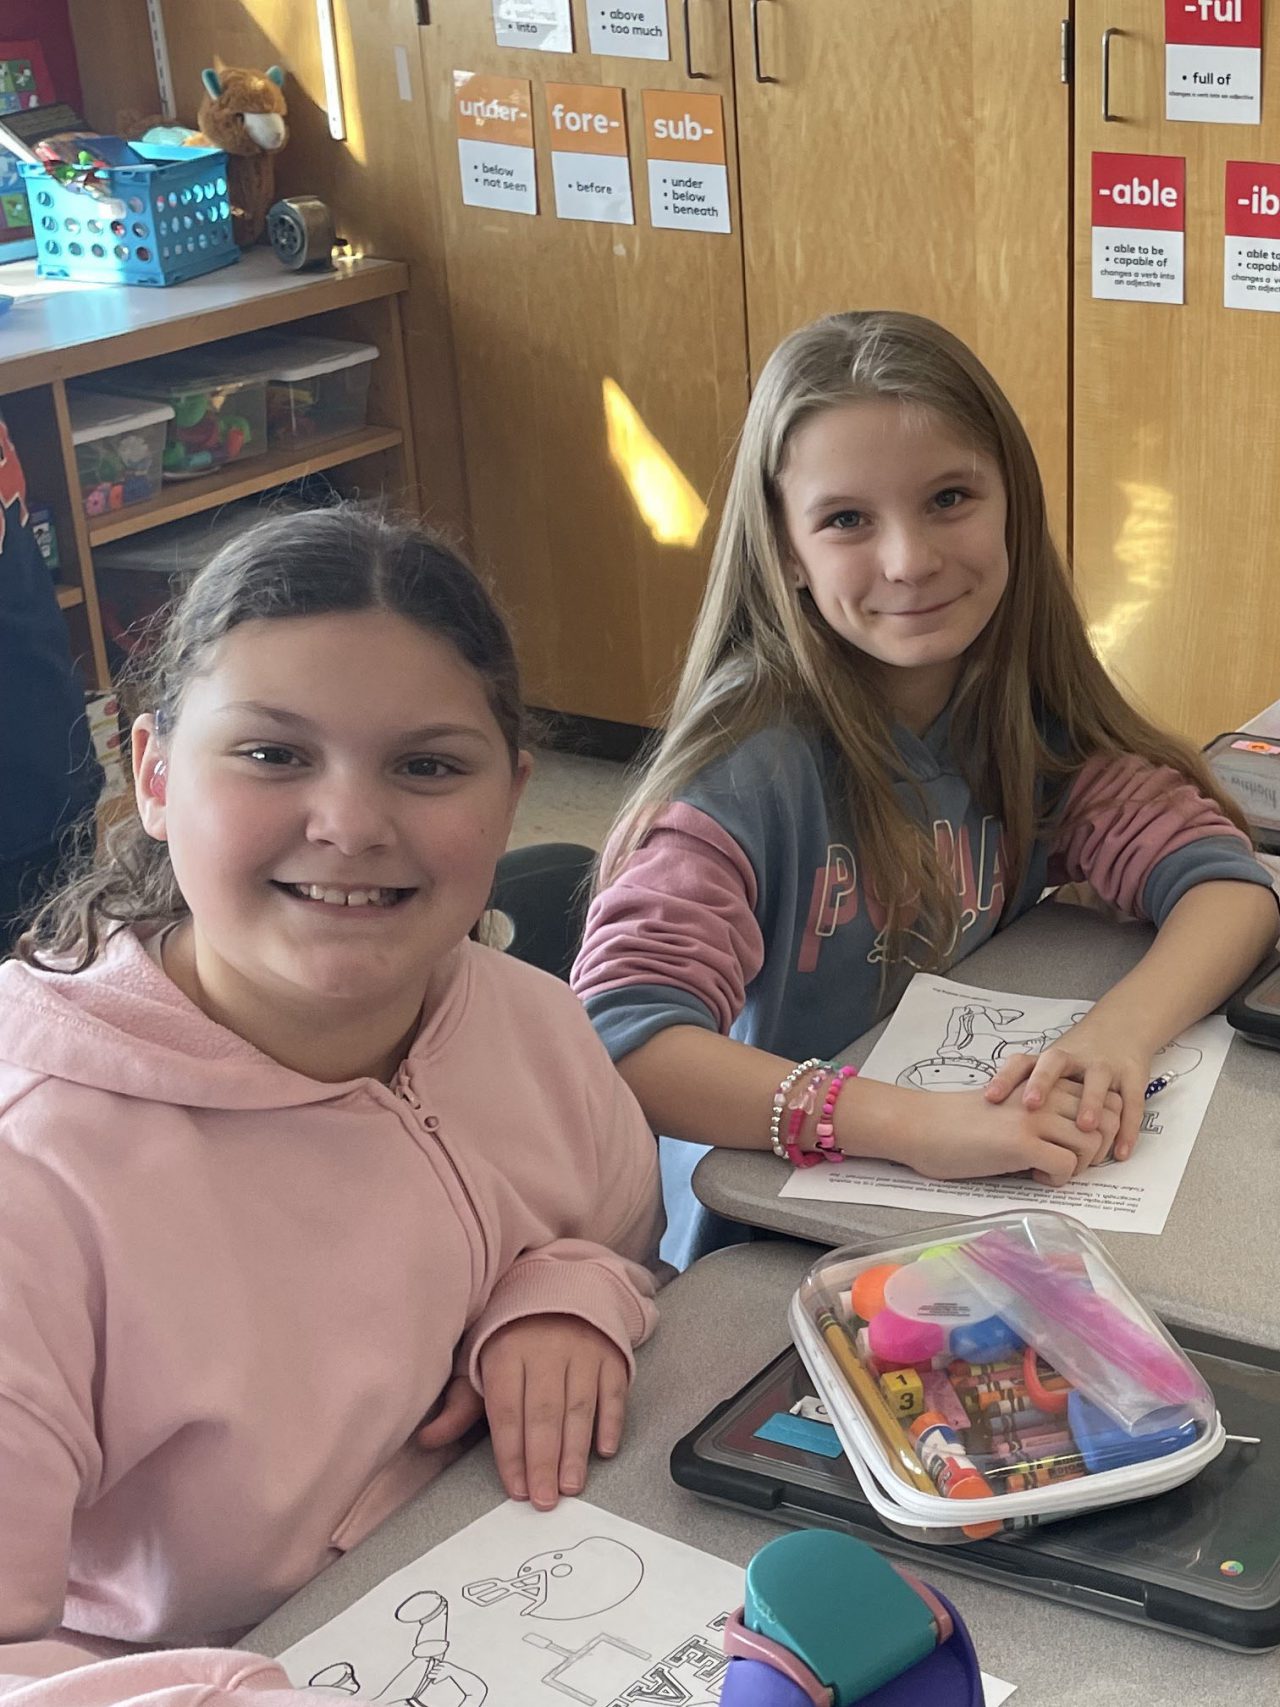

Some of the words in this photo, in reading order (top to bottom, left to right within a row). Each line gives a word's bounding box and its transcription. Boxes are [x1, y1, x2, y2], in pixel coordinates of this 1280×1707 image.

[610, 9, 645, 22] above
[516, 22, 538, 34] into
[610, 23, 630, 35] too
[632, 26, 663, 37] much
[1193, 71, 1213, 84] full
[1217, 73, 1231, 85] of
[460, 99, 528, 122] under-
[552, 103, 620, 134] fore-
[653, 113, 714, 141] sub-
[482, 163, 514, 177] below
[483, 178, 501, 189] not
[503, 181, 527, 193] seen
[576, 181, 613, 195] before
[671, 177, 704, 189] under
[672, 189, 706, 203] below
[1098, 177, 1178, 208] -able
[673, 203, 719, 217] beneath
[1113, 244, 1136, 254] able
[1138, 246, 1149, 255] to
[1151, 246, 1164, 255] be
[1246, 249, 1269, 260] able
[1113, 256, 1154, 268] capable
[1156, 258, 1168, 267] of
[1100, 269, 1132, 279] changes
[1231, 273, 1264, 284] changes
[1126, 279, 1161, 288] adjective
[896, 1373, 908, 1386] 1
[899, 1392, 914, 1411] 3
